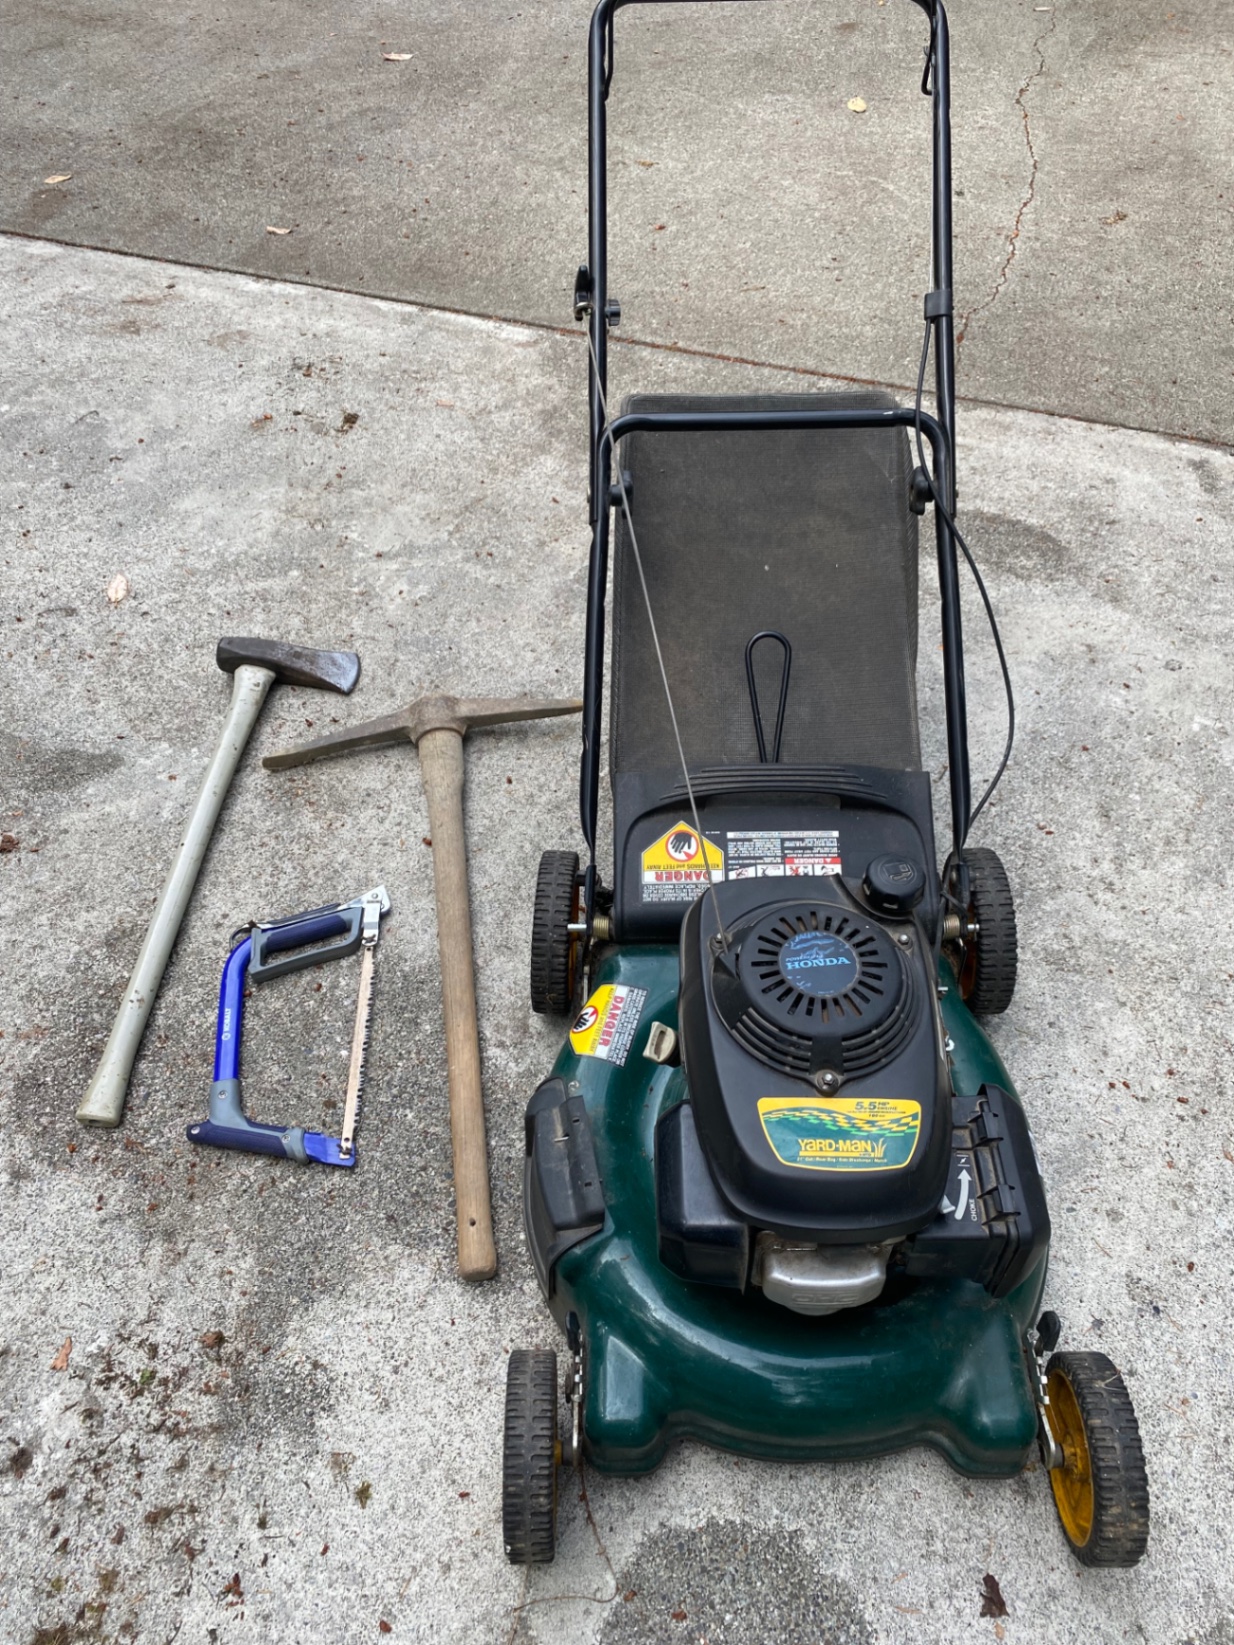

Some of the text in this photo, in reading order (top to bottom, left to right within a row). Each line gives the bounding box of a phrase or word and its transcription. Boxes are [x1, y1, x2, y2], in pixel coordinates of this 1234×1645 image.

[655, 870, 711, 882] DANGER
[786, 957, 851, 970] HONDA
[599, 995, 625, 1047] DANGER
[855, 1101, 877, 1111] 5.5
[969, 1199, 978, 1222] CHOKE
